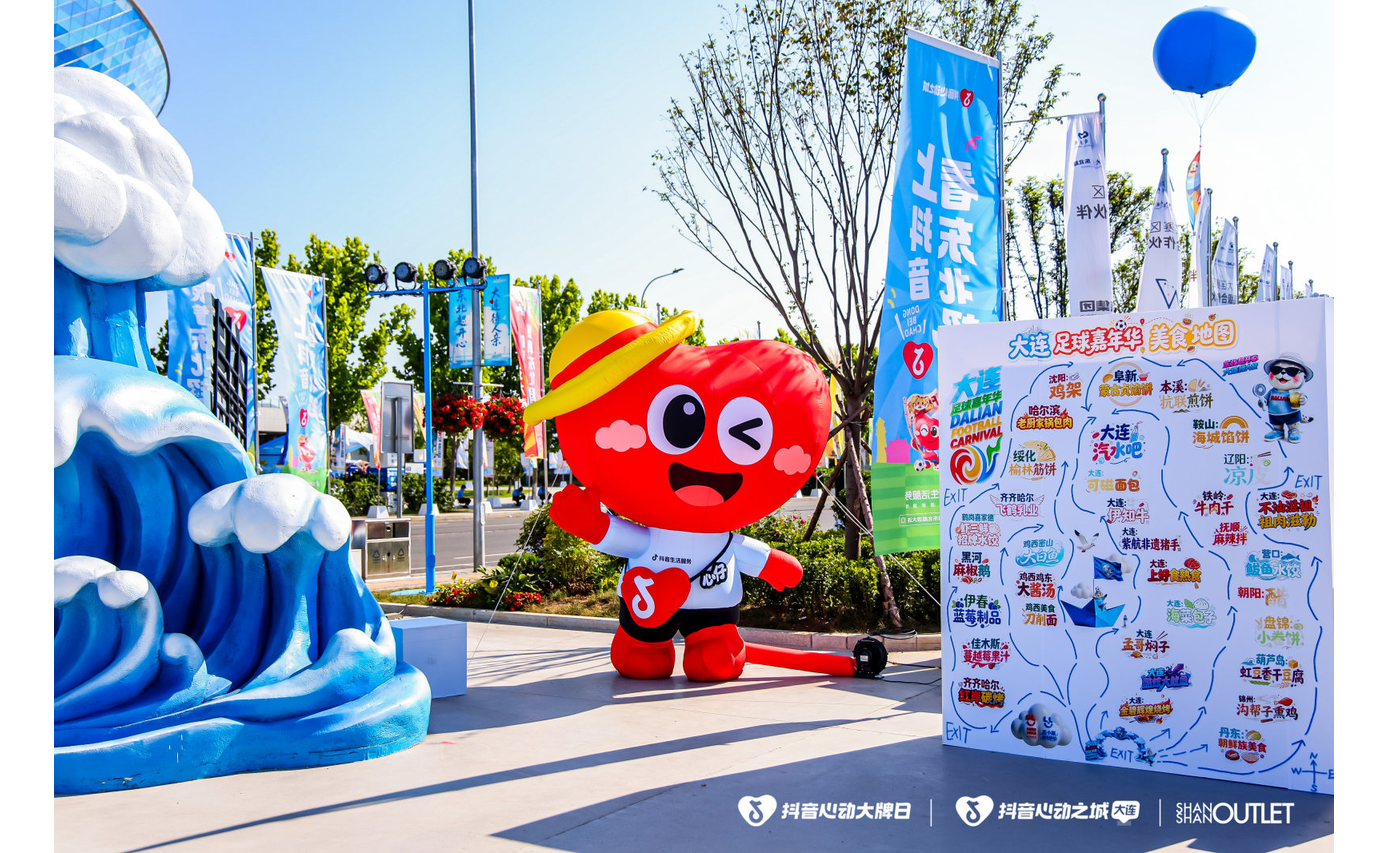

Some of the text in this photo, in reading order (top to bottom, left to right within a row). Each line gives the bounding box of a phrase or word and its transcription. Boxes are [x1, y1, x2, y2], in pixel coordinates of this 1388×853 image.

[1009, 320, 1236, 358] 大连 足球嘉年华 美食地图
[949, 365, 1002, 403] 大连
[1049, 382, 1082, 399] 鸡架
[950, 401, 1003, 429] DALIAN
[1028, 405, 1061, 416] 哈尔滨
[951, 416, 1002, 439] FOOTBALL
[1100, 423, 1130, 441] 大连
[950, 426, 1003, 449] CARNIVAL
[1013, 450, 1036, 462] 绥化
[1092, 441, 1143, 461] 汽水吧
[1000, 493, 1034, 502] 齐齐哈尔
[659, 556, 692, 565] 抖音生活服务
[961, 551, 982, 563] 黑河
[702, 563, 727, 587] 心仔
[1017, 582, 1056, 598] 大酱汤
[964, 594, 988, 608] 伊春
[953, 609, 1001, 625] 蓝莓制品
[1024, 613, 1058, 627] 刀削面
[1136, 629, 1153, 639] 大连
[971, 638, 1001, 649] 佳木斯
[963, 677, 999, 690] 齐齐哈尔
[1110, 748, 1134, 762] EXIT
[1291, 767, 1302, 775] W
